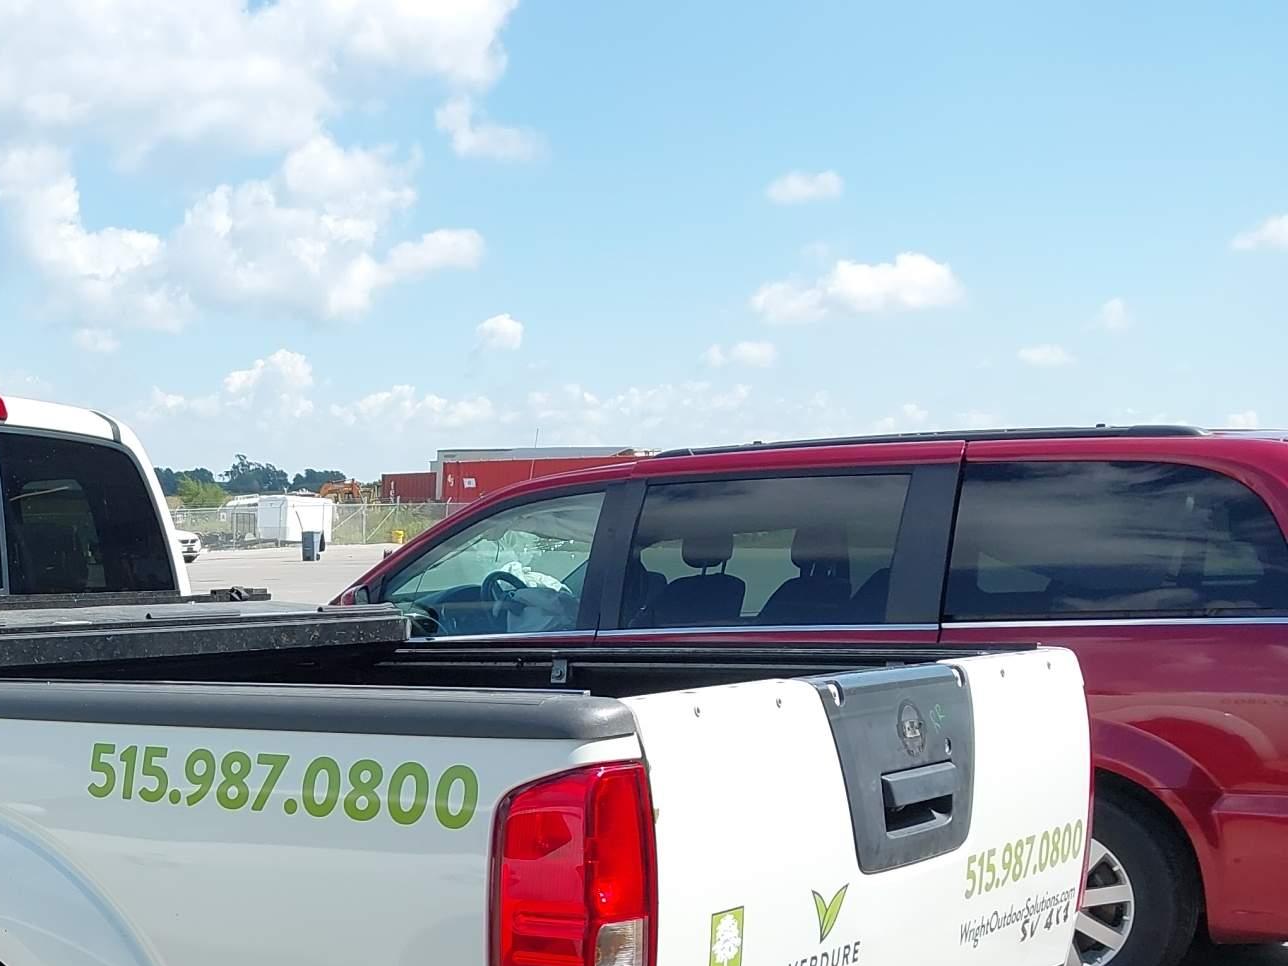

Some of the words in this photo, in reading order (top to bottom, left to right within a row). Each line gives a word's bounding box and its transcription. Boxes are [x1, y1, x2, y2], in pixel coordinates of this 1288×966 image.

[87, 742, 480, 830] 515.987.0800
[964, 818, 1083, 900] 515.987.0800
[959, 887, 1076, 948] WrightOutdoorSolutions.com
[1018, 914, 1040, 943] SV
